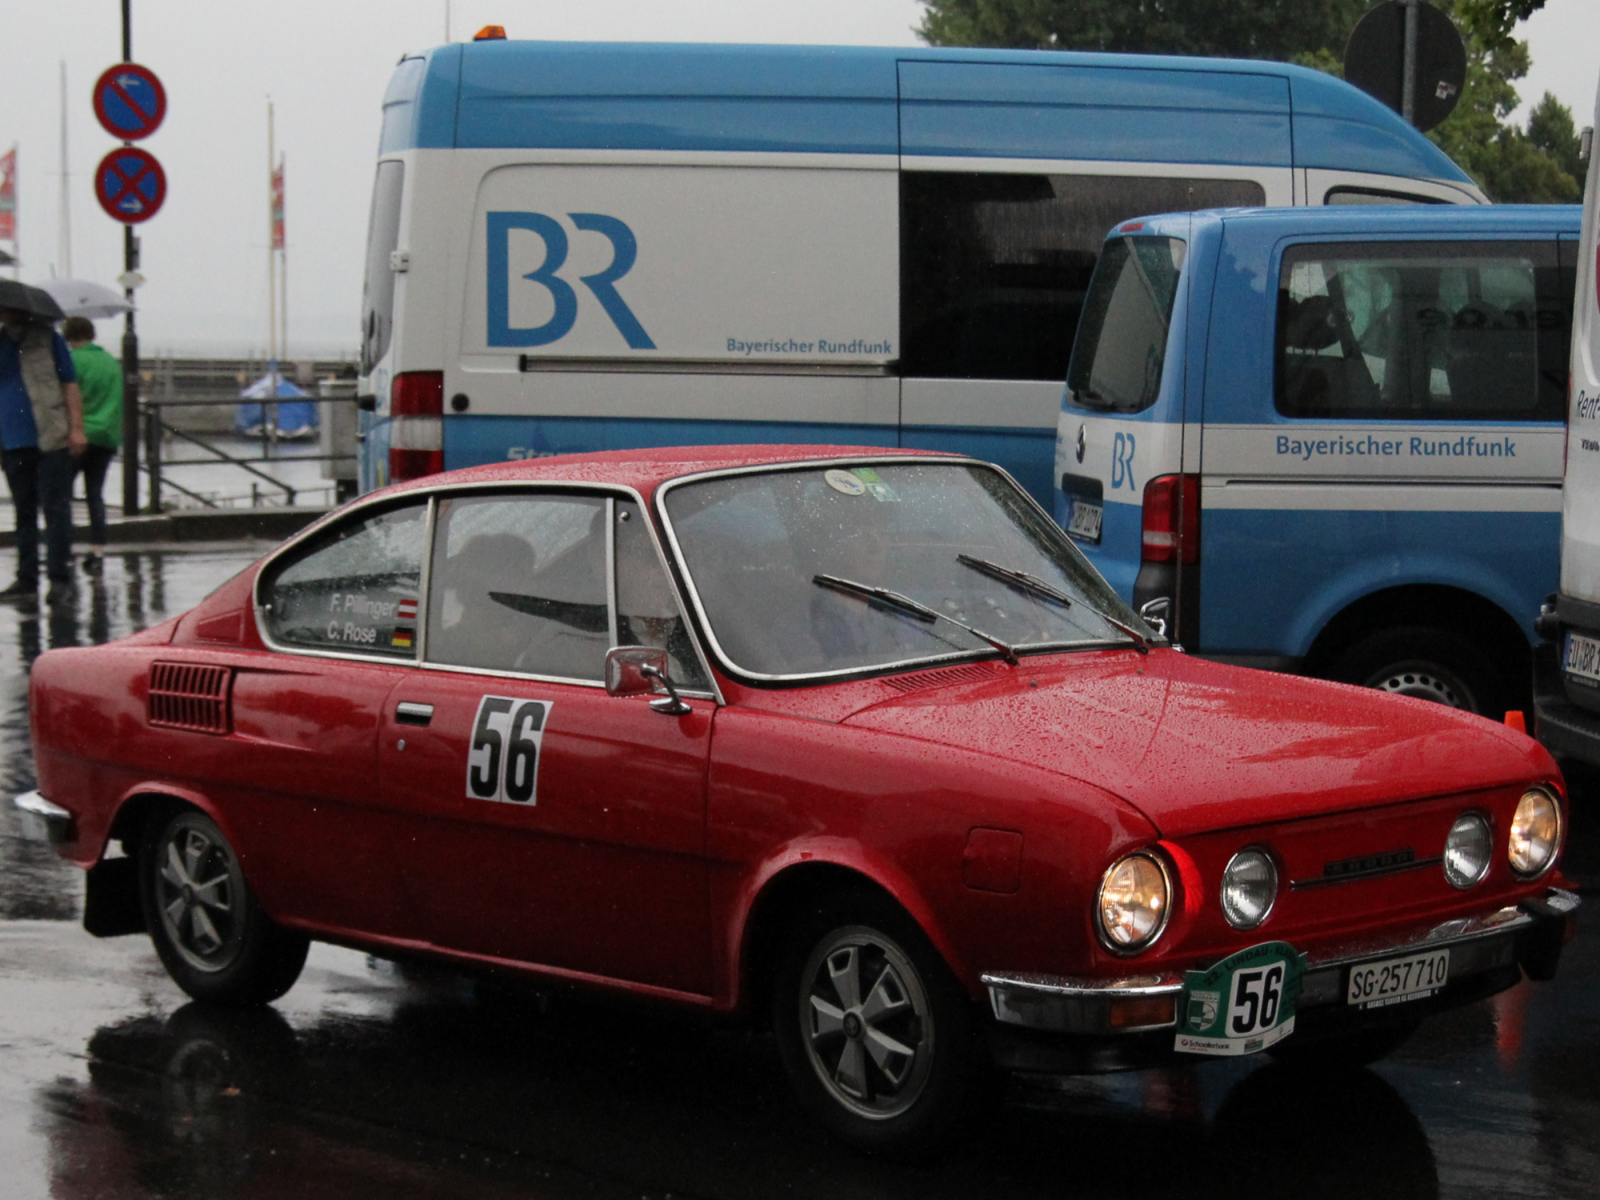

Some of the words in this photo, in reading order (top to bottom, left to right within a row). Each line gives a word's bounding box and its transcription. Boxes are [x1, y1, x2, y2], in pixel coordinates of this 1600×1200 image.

[487, 211, 658, 350] BR
[727, 338, 814, 355] Bayerischer
[818, 340, 892, 354] Rundfunk
[1112, 431, 1135, 491] BR
[1276, 436, 1403, 461] Bayerischer
[1409, 437, 1516, 457] Rundfunk
[330, 593, 341, 612] F.
[327, 620, 340, 640] C.
[343, 622, 377, 643] Rose
[470, 697, 546, 802] 56
[1225, 946, 1269, 972] LINDAU
[1232, 966, 1282, 1033] 56
